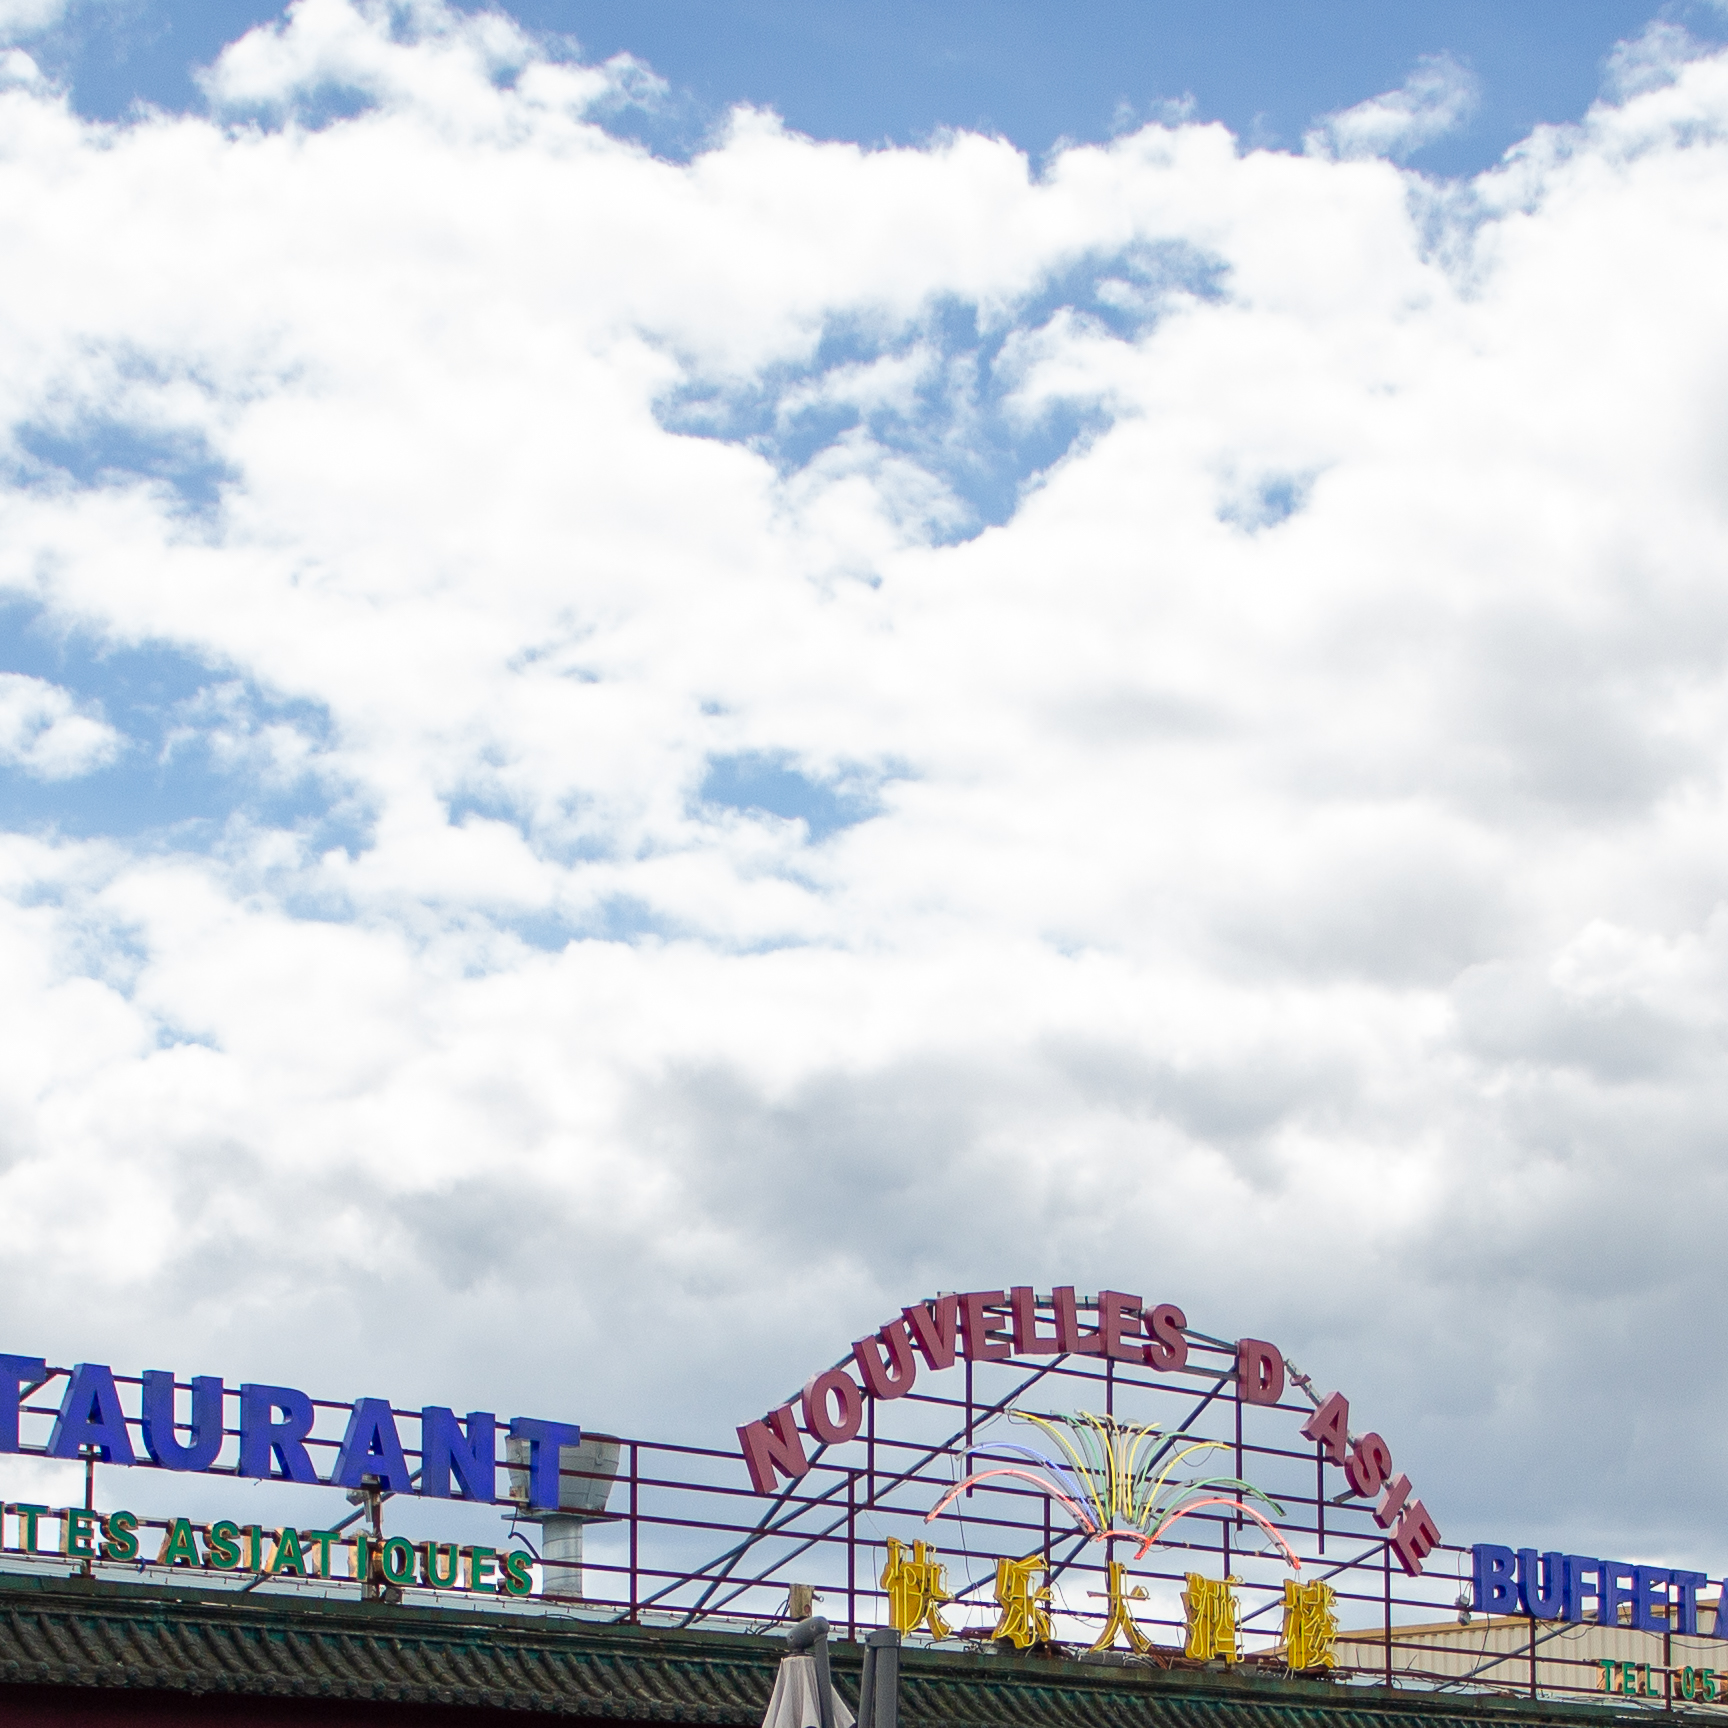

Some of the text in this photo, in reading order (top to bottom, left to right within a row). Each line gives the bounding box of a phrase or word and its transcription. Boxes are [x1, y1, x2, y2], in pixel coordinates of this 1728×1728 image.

[736, 1285, 1188, 1495] NOUVELLES
[158, 1515, 534, 1597] ASIATIQUES
[1472, 1543, 1707, 1638] BUFFET
[1598, 1659, 1658, 1698] TEL
